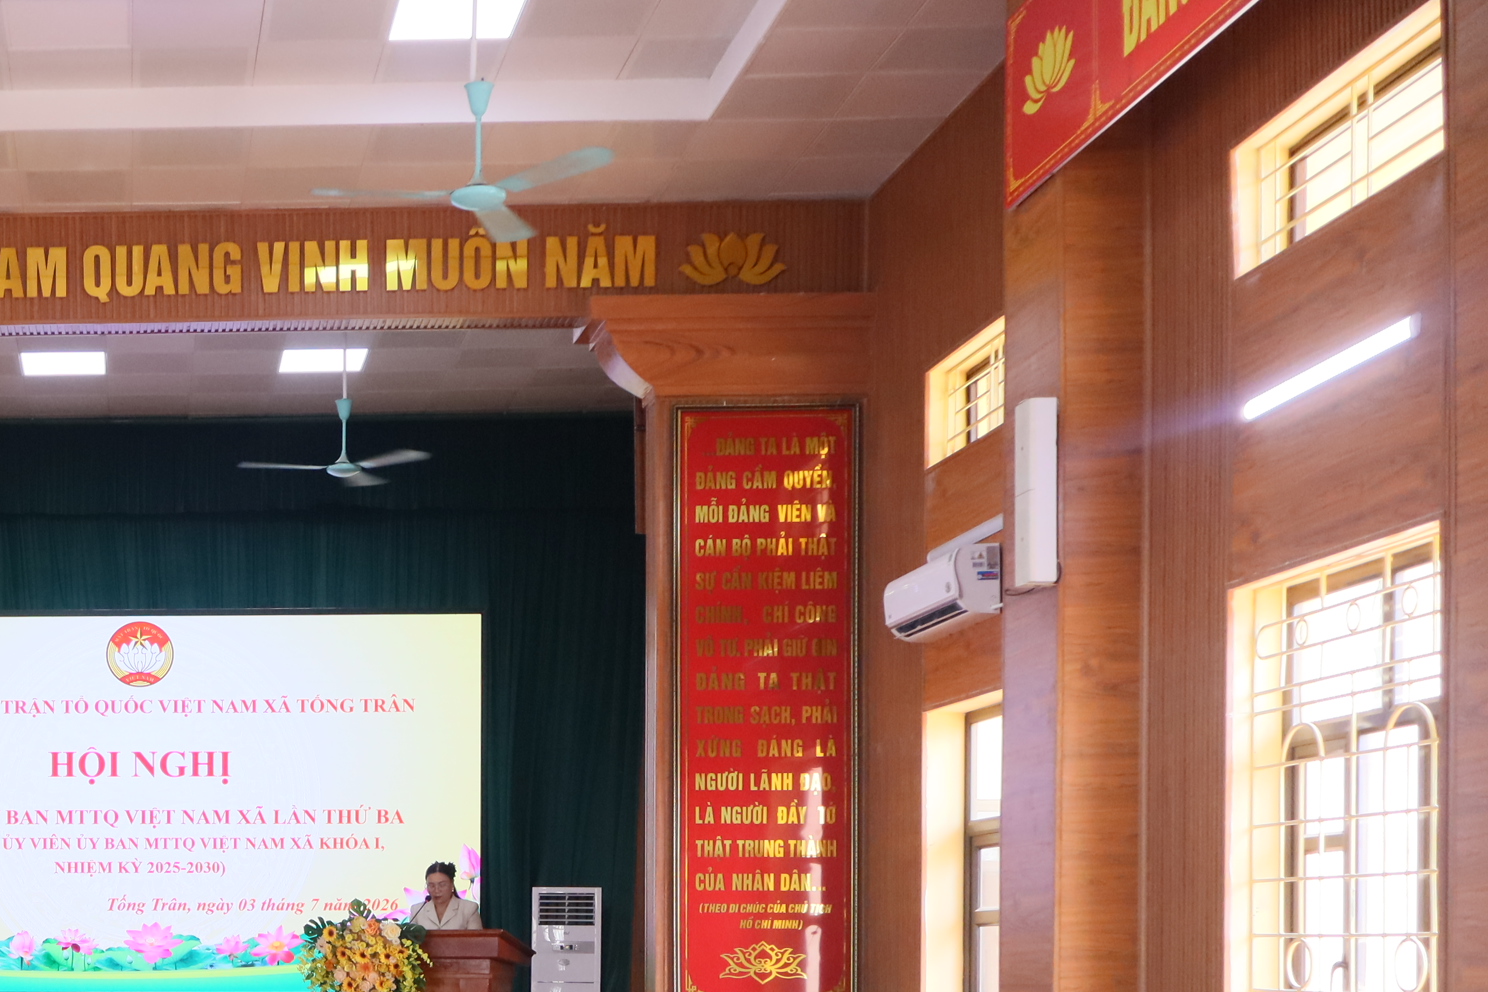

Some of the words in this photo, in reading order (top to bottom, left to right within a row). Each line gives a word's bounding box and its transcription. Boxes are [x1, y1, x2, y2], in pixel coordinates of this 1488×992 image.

[83, 242, 242, 303] QUANG
[257, 239, 369, 292] VINH
[386, 227, 528, 291] MUÔN
[545, 223, 656, 288] NĂM
[760, 438, 777, 455] TA
[782, 432, 800, 455] LÀ
[806, 432, 836, 459] MỘT
[696, 465, 736, 489] ĐẢNG
[743, 464, 776, 489] CẦM
[696, 498, 723, 523] MỖI
[728, 498, 770, 522] ĐẢNG
[778, 500, 811, 522] VIÊN
[817, 500, 836, 522] VÀ
[696, 535, 726, 556] CÁN
[733, 535, 751, 561] BỘ
[757, 531, 793, 556] PHẢI
[799, 533, 836, 559] THẬT
[764, 601, 788, 623] CHÍ
[796, 601, 836, 623] CÔNG
[696, 666, 746, 690] ĐẢNG
[758, 673, 780, 690] TA
[791, 668, 836, 694] THẬT
[1, 697, 56, 718] TRẬN
[61, 696, 89, 714] TỔ
[95, 696, 152, 717] QUỐC
[159, 697, 205, 717] VIỆT
[211, 699, 258, 714] NAM
[263, 695, 291, 713] XÃ
[297, 695, 354, 713] TỐNG
[360, 694, 415, 713] TRÂN
[696, 706, 744, 724] TRONG
[751, 706, 796, 727] SẠCH,
[802, 699, 837, 723] PHẢI
[696, 735, 742, 757] XỨNG
[758, 735, 803, 757] ĐÁNG
[816, 735, 836, 757] LÀ
[48, 746, 120, 784] HỘI
[131, 751, 232, 784] NGHỊ
[696, 768, 743, 790] NGƯỜI
[750, 769, 792, 790] LÃNH
[6, 810, 49, 824] BAN
[56, 809, 119, 828] MTTQ
[125, 807, 175, 829] VIỆT
[181, 810, 230, 824] NAM
[237, 806, 267, 824] XÃ
[273, 805, 317, 824] LẦN
[323, 805, 372, 824] THỨ
[376, 810, 404, 824] BA
[696, 802, 714, 824] LÀ
[721, 802, 767, 824] NGƯỜI
[777, 799, 807, 824] ĐẦY
[3, 834, 26, 850] ỦY
[30, 834, 71, 849] VIÊN
[77, 834, 100, 849] ỦY
[104, 837, 139, 850] BAN
[144, 837, 195, 852] MTTQ
[200, 835, 241, 853] VIỆT
[245, 837, 285, 850] NAM
[290, 835, 314, 849] XÃ
[319, 834, 369, 849] KHÓA
[374, 837, 385, 851] I,
[696, 836, 732, 861] THẬT
[737, 840, 784, 857] TRUNG
[788, 835, 836, 858] THÀNH
[54, 860, 112, 877] NHIỆM
[118, 858, 142, 874] KỲ
[147, 861, 226, 877] 2025-2030)
[696, 867, 725, 891] CỦA
[733, 870, 774, 891] NHÂN
[107, 895, 146, 914] Tống
[152, 898, 191, 913] Trân,
[197, 901, 233, 914] ngày
[238, 898, 256, 911] 03
[261, 898, 305, 914] tháng
[311, 899, 320, 911] 7
[363, 898, 399, 911] 2026
[700, 904, 727, 914] (THEO
[729, 904, 738, 913] DI
[740, 902, 765, 913] CHÚC
[767, 900, 786, 913] CỦA
[788, 901, 808, 913] CHỦ
[740, 916, 753, 928] HỒ
[755, 918, 770, 928] CHÍ
[773, 920, 803, 930] MINH)
